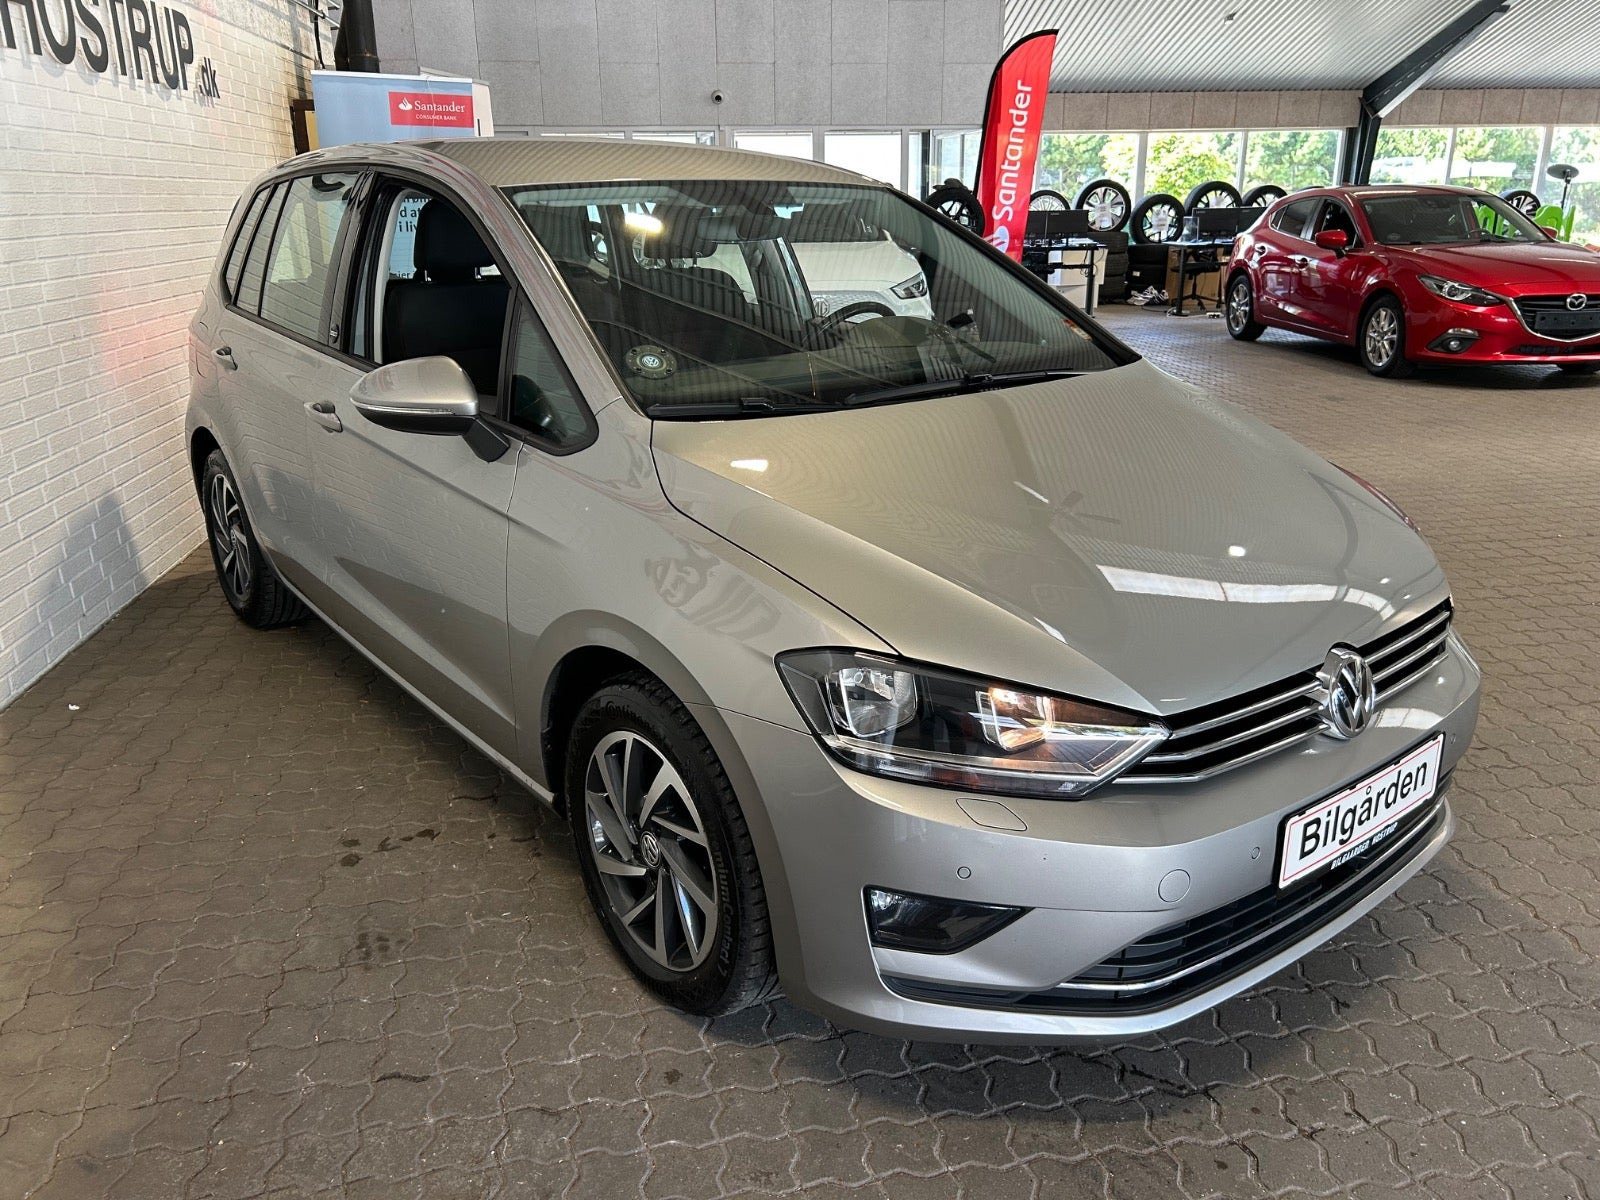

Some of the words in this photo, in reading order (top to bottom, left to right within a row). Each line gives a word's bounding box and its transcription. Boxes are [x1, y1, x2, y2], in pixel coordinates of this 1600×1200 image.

[414, 101, 465, 113] Santander
[992, 80, 1032, 221] Santander
[1299, 761, 1428, 861] Bilgården
